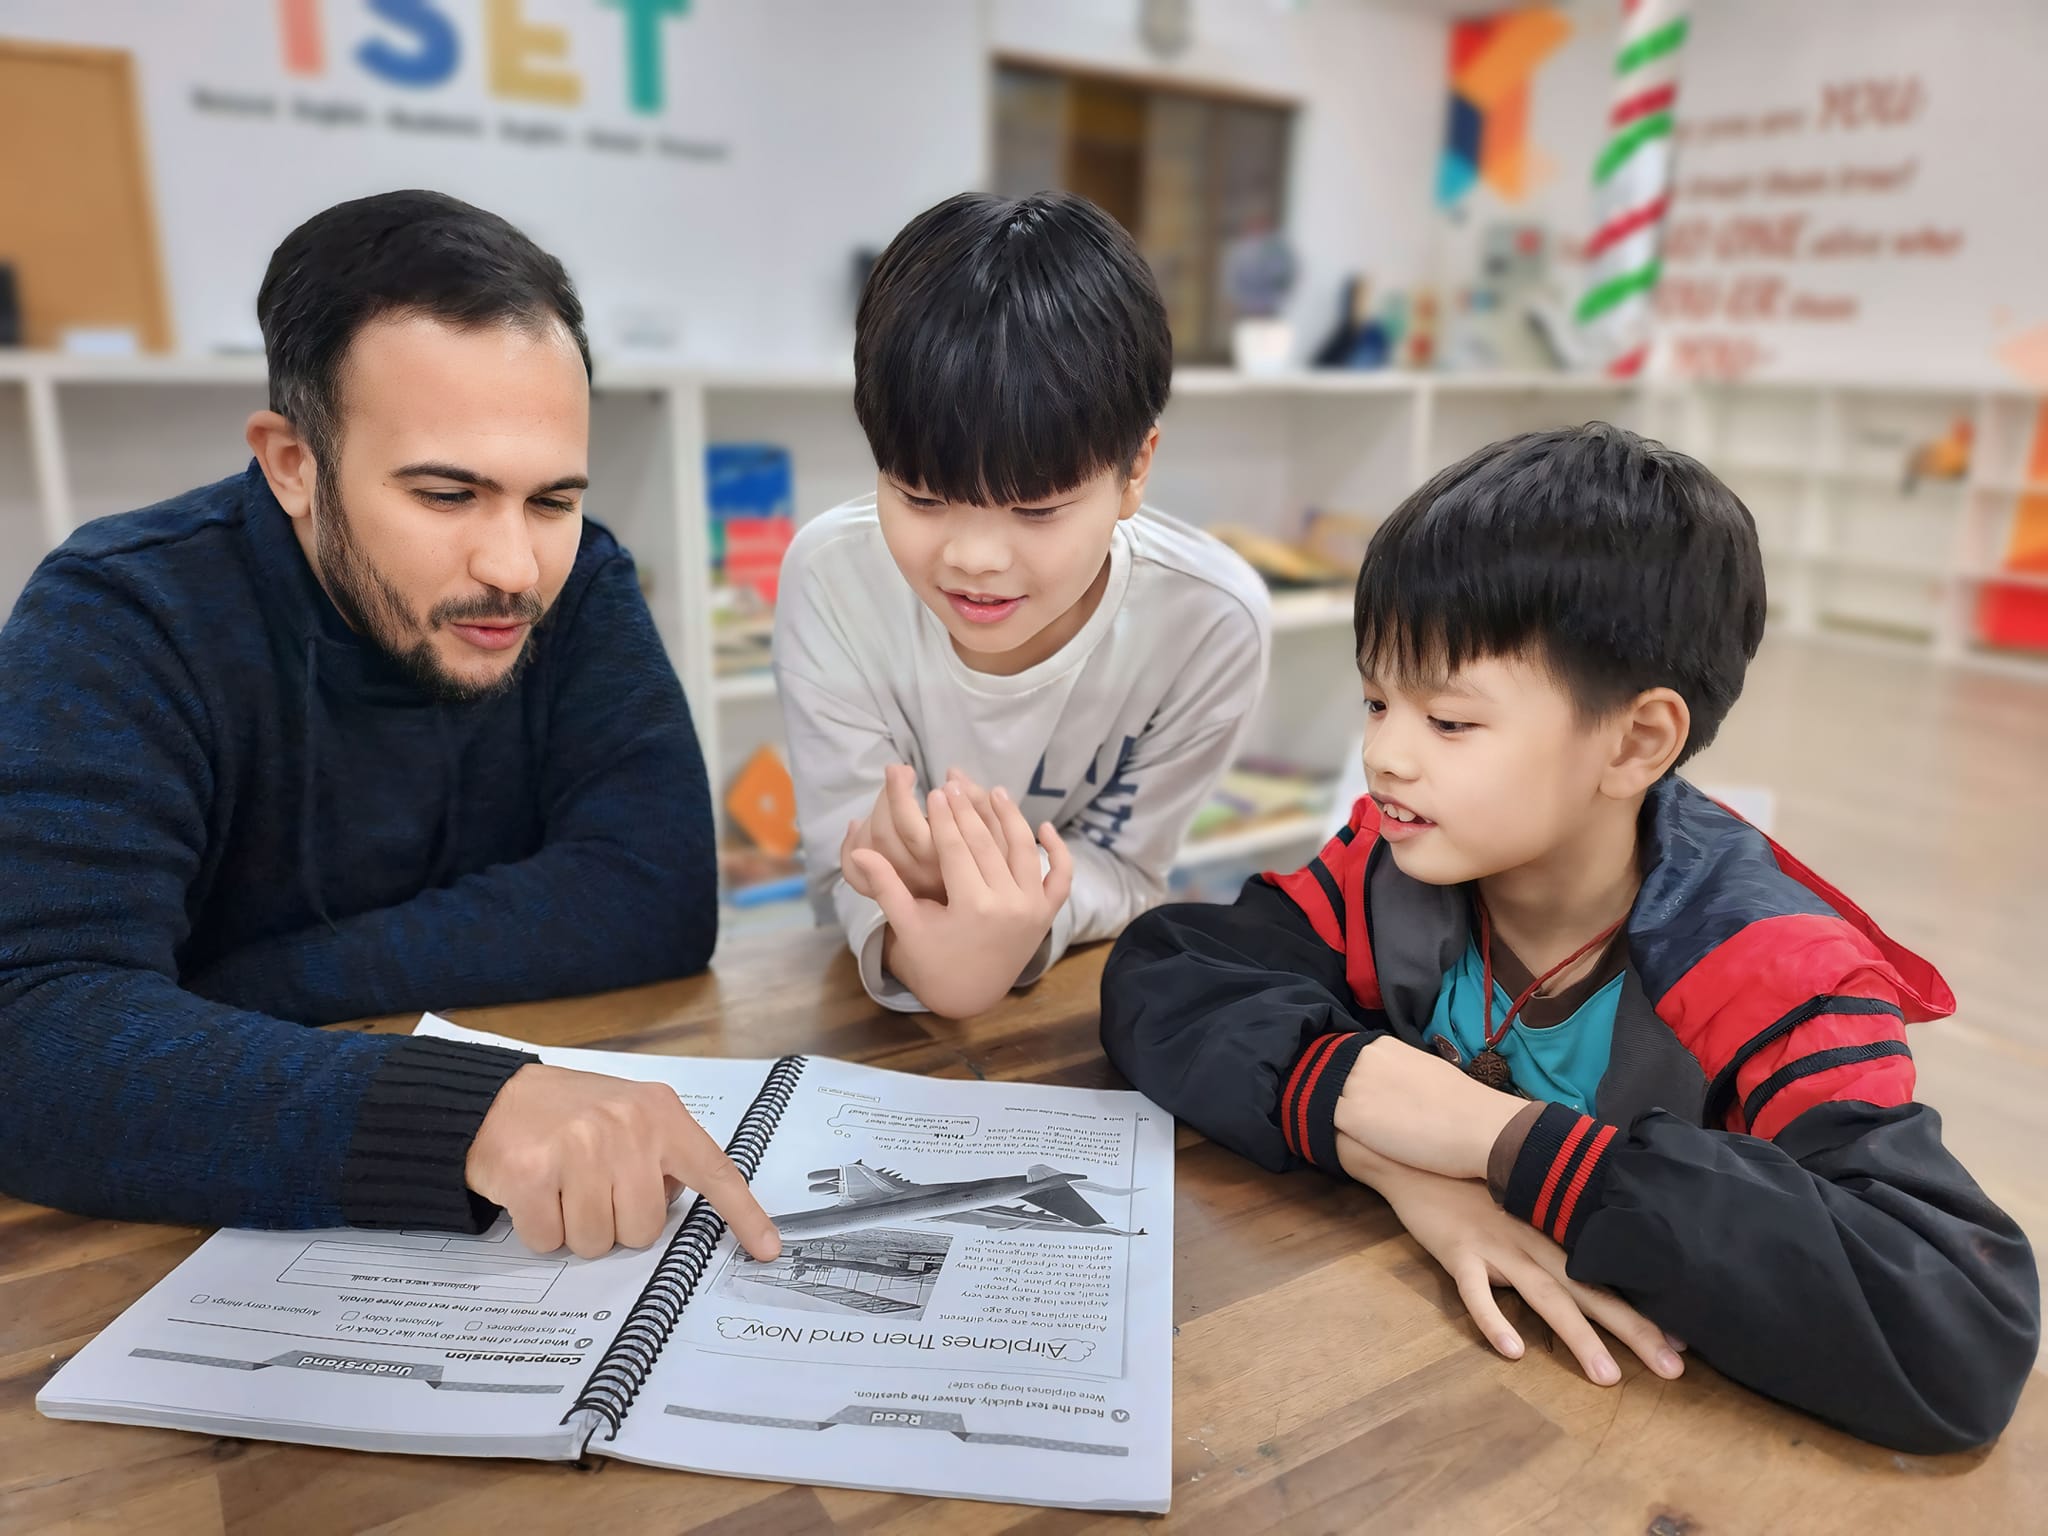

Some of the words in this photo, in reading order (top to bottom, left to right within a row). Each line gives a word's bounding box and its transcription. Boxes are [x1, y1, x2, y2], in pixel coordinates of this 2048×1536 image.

[932, 1132, 965, 1140] Think
[996, 1238, 1018, 1248] very
[1036, 1241, 1066, 1251] today
[1067, 1243, 1113, 1252] airplanes
[964, 1246, 982, 1254] but
[963, 1254, 985, 1263] first
[985, 1257, 1005, 1265] The
[1066, 1252, 1113, 1262] airplanes
[954, 1261, 978, 1271] they
[978, 1264, 1000, 1273] and
[1045, 1261, 1059, 1269] of
[1060, 1262, 1075, 1271] lot
[1085, 1262, 1112, 1271] carry
[1022, 1267, 1045, 1276] very
[1063, 1271, 1111, 1281] airplanes
[380, 1277, 403, 1285] very
[404, 1279, 430, 1287] were
[992, 1276, 1019, 1285] Now
[1052, 1278, 1067, 1288] by
[1067, 1281, 1111, 1289] traveled
[431, 1281, 482, 1292] Airplanes
[973, 1282, 1010, 1292] people
[1010, 1284, 1041, 1294] many
[960, 1290, 984, 1298] very
[984, 1293, 1010, 1301] were
[1041, 1289, 1063, 1297] not
[210, 1297, 244, 1308] things
[375, 1298, 405, 1307] three
[1011, 1294, 1032, 1303] ago
[1033, 1296, 1057, 1307] long
[1059, 1298, 1109, 1308] Airplanes
[242, 1300, 273, 1310] carry
[403, 1300, 428, 1308] and
[426, 1302, 451, 1311] text
[451, 1304, 471, 1312] the
[468, 1305, 484, 1313] of
[271, 1305, 322, 1317] Airplanes
[483, 1306, 510, 1316] idea
[509, 1308, 540, 1316] main
[539, 1309, 559, 1318] the
[559, 1310, 589, 1319] Write
[1003, 1306, 1029, 1318] long
[1030, 1310, 1080, 1321] airplanes
[361, 1312, 393, 1324] today
[394, 1316, 445, 1328] Airplanes
[938, 1313, 985, 1324] different
[985, 1315, 1009, 1324] very
[1081, 1313, 1108, 1322] from
[354, 1325, 390, 1336] Check
[485, 1323, 536, 1333] airplanes
[535, 1326, 558, 1334] first
[557, 1327, 578, 1335] The
[1055, 1321, 1108, 1333] Airplanes
[388, 1328, 417, 1339] like?
[416, 1330, 440, 1339] you
[439, 1333, 456, 1342] do
[742, 1323, 804, 1342] Now
[808, 1328, 865, 1344] and
[454, 1334, 479, 1342] text
[479, 1335, 499, 1344] the
[496, 1336, 513, 1345] of
[512, 1336, 540, 1345] part
[538, 1338, 570, 1347] What
[872, 1332, 936, 1351] Then
[941, 1335, 1068, 1359] Airplanes
[444, 1350, 582, 1366] Comprehension
[297, 1355, 414, 1377] Understand
[947, 1381, 975, 1391] safe?
[976, 1381, 999, 1391] ago
[999, 1382, 1025, 1395] long
[1026, 1386, 1077, 1399] airplanes
[1078, 1391, 1106, 1404] Were
[910, 1393, 930, 1403] the
[931, 1395, 977, 1406] Answer
[1025, 1400, 1049, 1411] text
[1051, 1403, 1072, 1414] the
[1073, 1405, 1105, 1419] Read
[869, 1410, 922, 1426] Read
